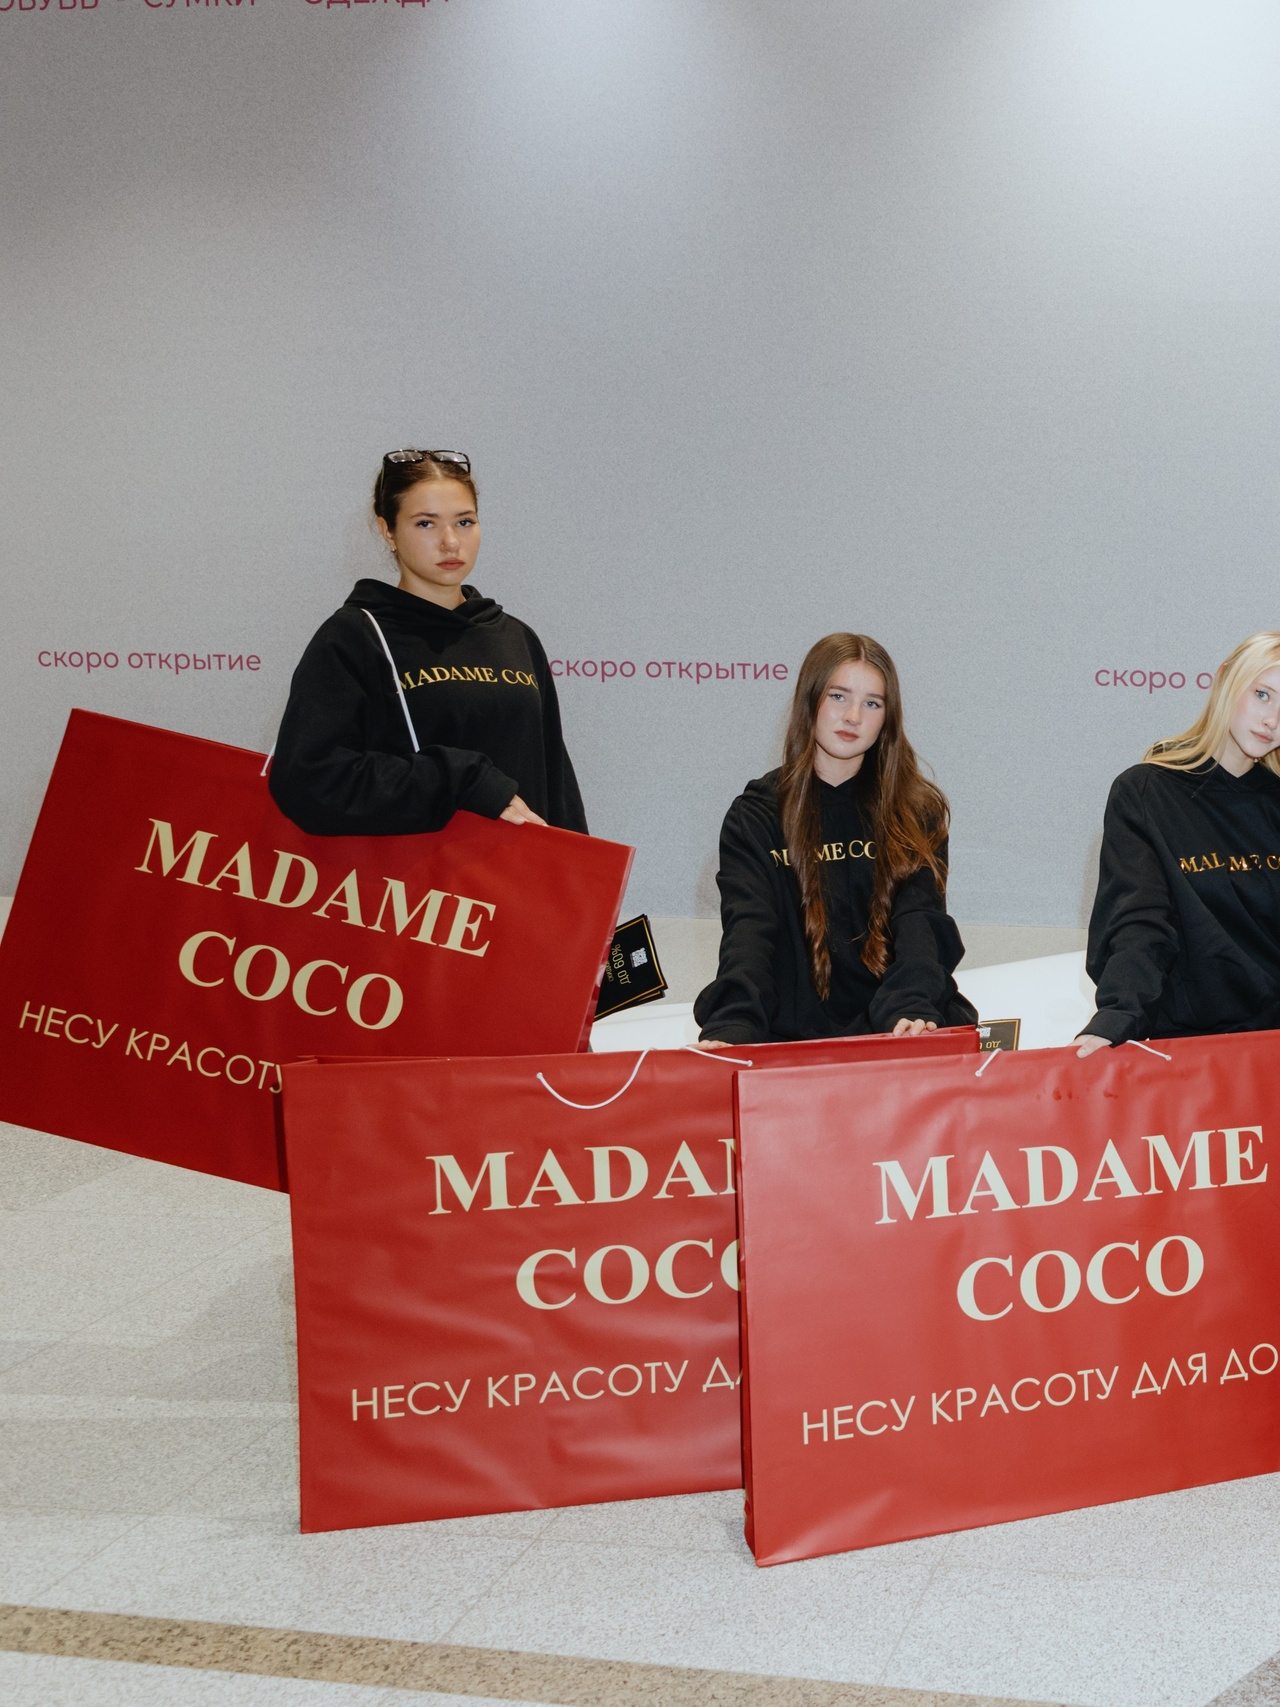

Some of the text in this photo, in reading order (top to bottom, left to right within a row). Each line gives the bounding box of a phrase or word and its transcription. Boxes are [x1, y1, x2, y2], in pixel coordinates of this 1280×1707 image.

[37, 650, 262, 676] скоро открытие
[396, 665, 498, 694] MADAME
[549, 658, 789, 685] скоро открытие
[1095, 669, 1187, 694] скоро
[134, 818, 497, 958] MADAME
[178, 931, 404, 1030] COCO
[18, 1000, 119, 1049] НЕСУ
[425, 1138, 737, 1216] MADA
[872, 1125, 1269, 1225] MADAME
[956, 1235, 1205, 1322] COCO
[351, 1378, 471, 1422] НЕСУ
[487, 1359, 690, 1409] КРАСОТУ
[802, 1395, 916, 1445] НЕСУ
[931, 1365, 1120, 1425] КРАСОТУ
[1132, 1352, 1208, 1399] ДЛЯ
